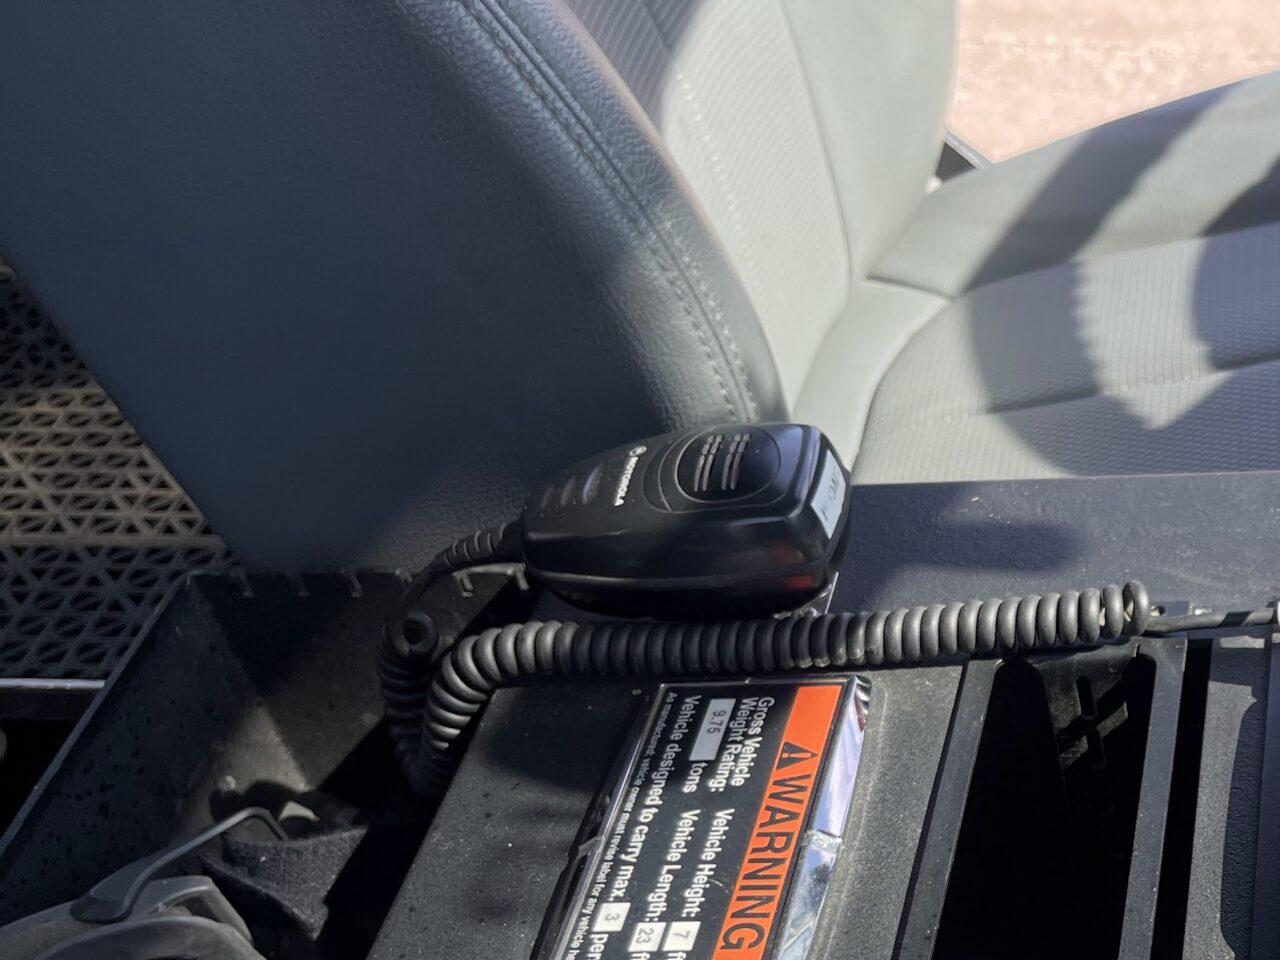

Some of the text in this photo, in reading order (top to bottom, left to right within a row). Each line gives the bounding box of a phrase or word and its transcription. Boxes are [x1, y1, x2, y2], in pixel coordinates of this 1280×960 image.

[614, 457, 639, 507] MOTOROLA
[667, 692, 678, 702] As
[671, 694, 702, 742] Vehicle
[683, 710, 727, 794] 9.75 tons
[710, 696, 758, 792] Weight Rating:
[729, 696, 775, 787] Gross Vehicle
[634, 757, 650, 786] vehicle
[648, 743, 682, 806] designed
[624, 785, 640, 812] owner
[639, 805, 659, 823] to
[615, 812, 630, 834] must
[666, 808, 701, 861] Vehicle
[701, 808, 736, 861] Vehicle
[604, 834, 622, 861] revise
[620, 825, 649, 863] carry
[720, 773, 812, 950] WARNING
[596, 861, 614, 884] label
[608, 865, 635, 902] max.
[582, 897, 598, 915] any
[591, 883, 606, 898] for
[645, 864, 681, 922] Length:
[682, 864, 716, 918] Height:
[570, 915, 591, 949] vehicle
[604, 913, 620, 922] 3
[674, 929, 690, 939] 7
[635, 928, 654, 945] 23
